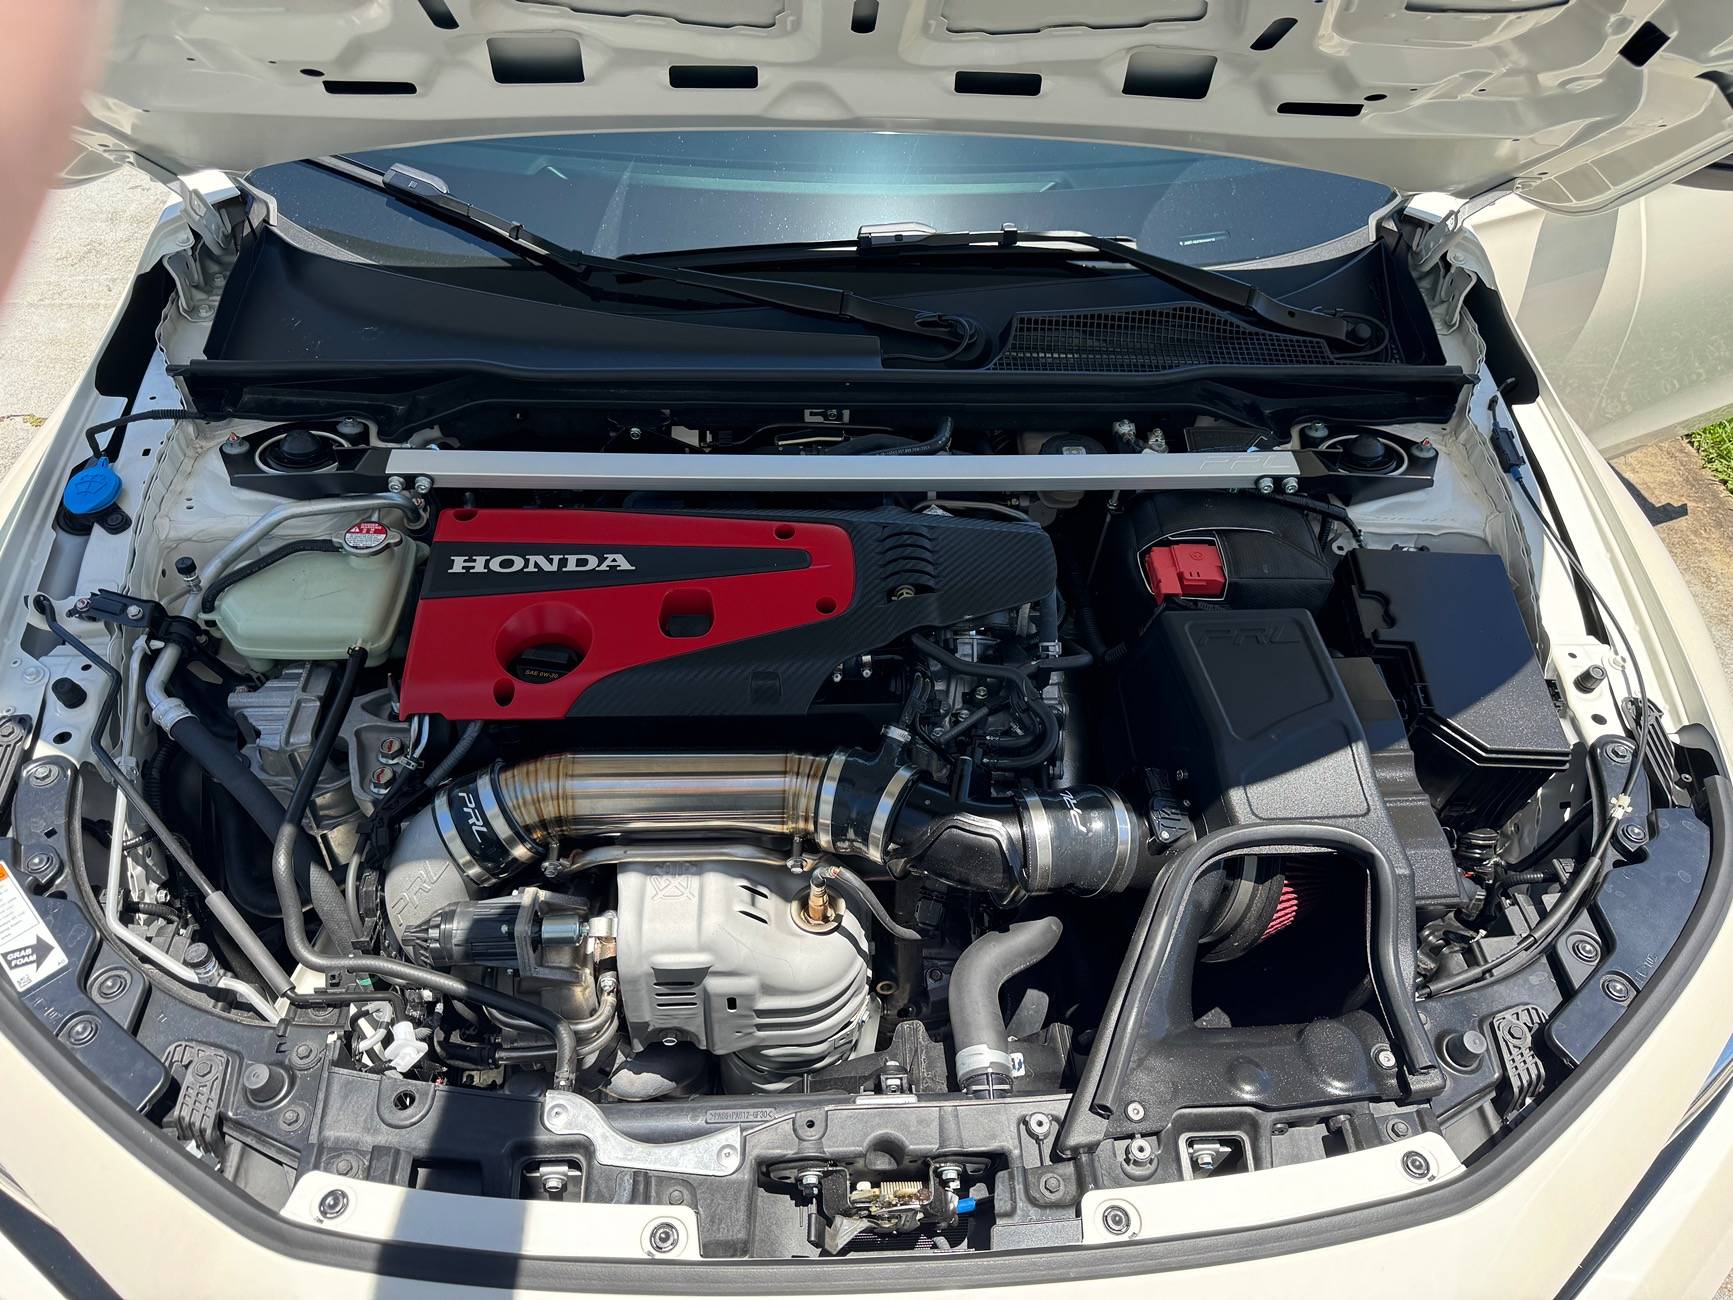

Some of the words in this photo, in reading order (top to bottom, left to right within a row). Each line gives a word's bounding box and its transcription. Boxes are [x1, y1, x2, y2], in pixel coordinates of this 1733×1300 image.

[1199, 454, 1291, 471] PRL
[447, 553, 636, 573] HONDA
[1197, 622, 1302, 646] PRL
[458, 792, 488, 843] PRL
[1060, 789, 1088, 833] PRL
[391, 859, 450, 928] PRL
[6, 948, 33, 960] GRAB
[11, 955, 37, 967] FOAM
